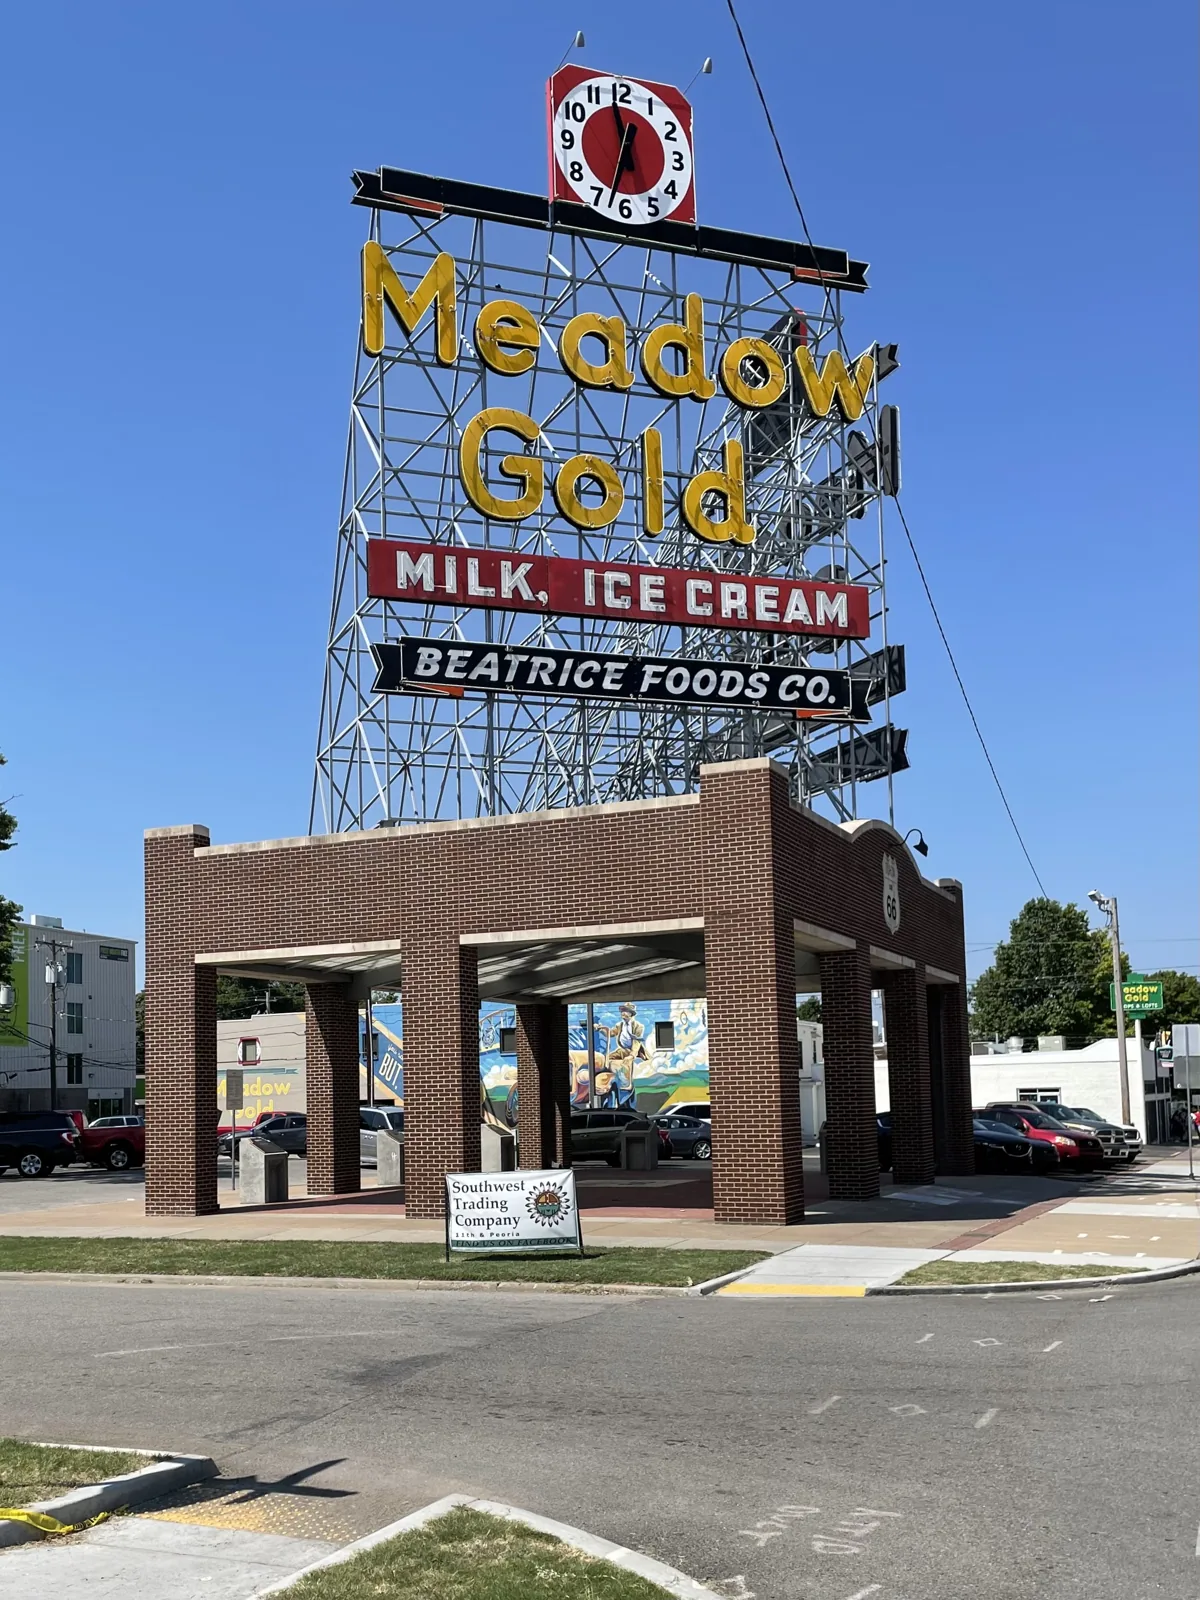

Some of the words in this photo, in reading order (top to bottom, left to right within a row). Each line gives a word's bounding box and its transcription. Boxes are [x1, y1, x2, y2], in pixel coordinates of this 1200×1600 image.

[587, 84, 600, 105] 11
[612, 82, 632, 104] 12
[564, 101, 586, 123] 10
[647, 97, 654, 116] 1
[560, 129, 575, 150] 9
[664, 121, 677, 142] 2
[569, 161, 584, 182] 8
[672, 151, 685, 172] 3
[590, 185, 604, 207] 7
[664, 179, 678, 200] 4
[618, 198, 632, 219] 6
[647, 196, 660, 217] 5
[361, 239, 875, 422] Meadow
[458, 406, 757, 546] Gold
[396, 549, 549, 608] MILK,
[583, 567, 667, 613] ICE
[686, 578, 849, 628] CREAM
[414, 646, 628, 692] BEATRICE
[639, 664, 770, 700] FOODS
[778, 673, 837, 704] CO.
[886, 895, 897, 920] 66
[1124, 993, 1149, 1002] Gold
[452, 1180, 525, 1194] Southwest
[453, 1197, 508, 1212] Trading
[455, 1214, 521, 1230] Company
[498, 1239, 514, 1247] ON
[517, 1236, 574, 1246] FACEBOOK
